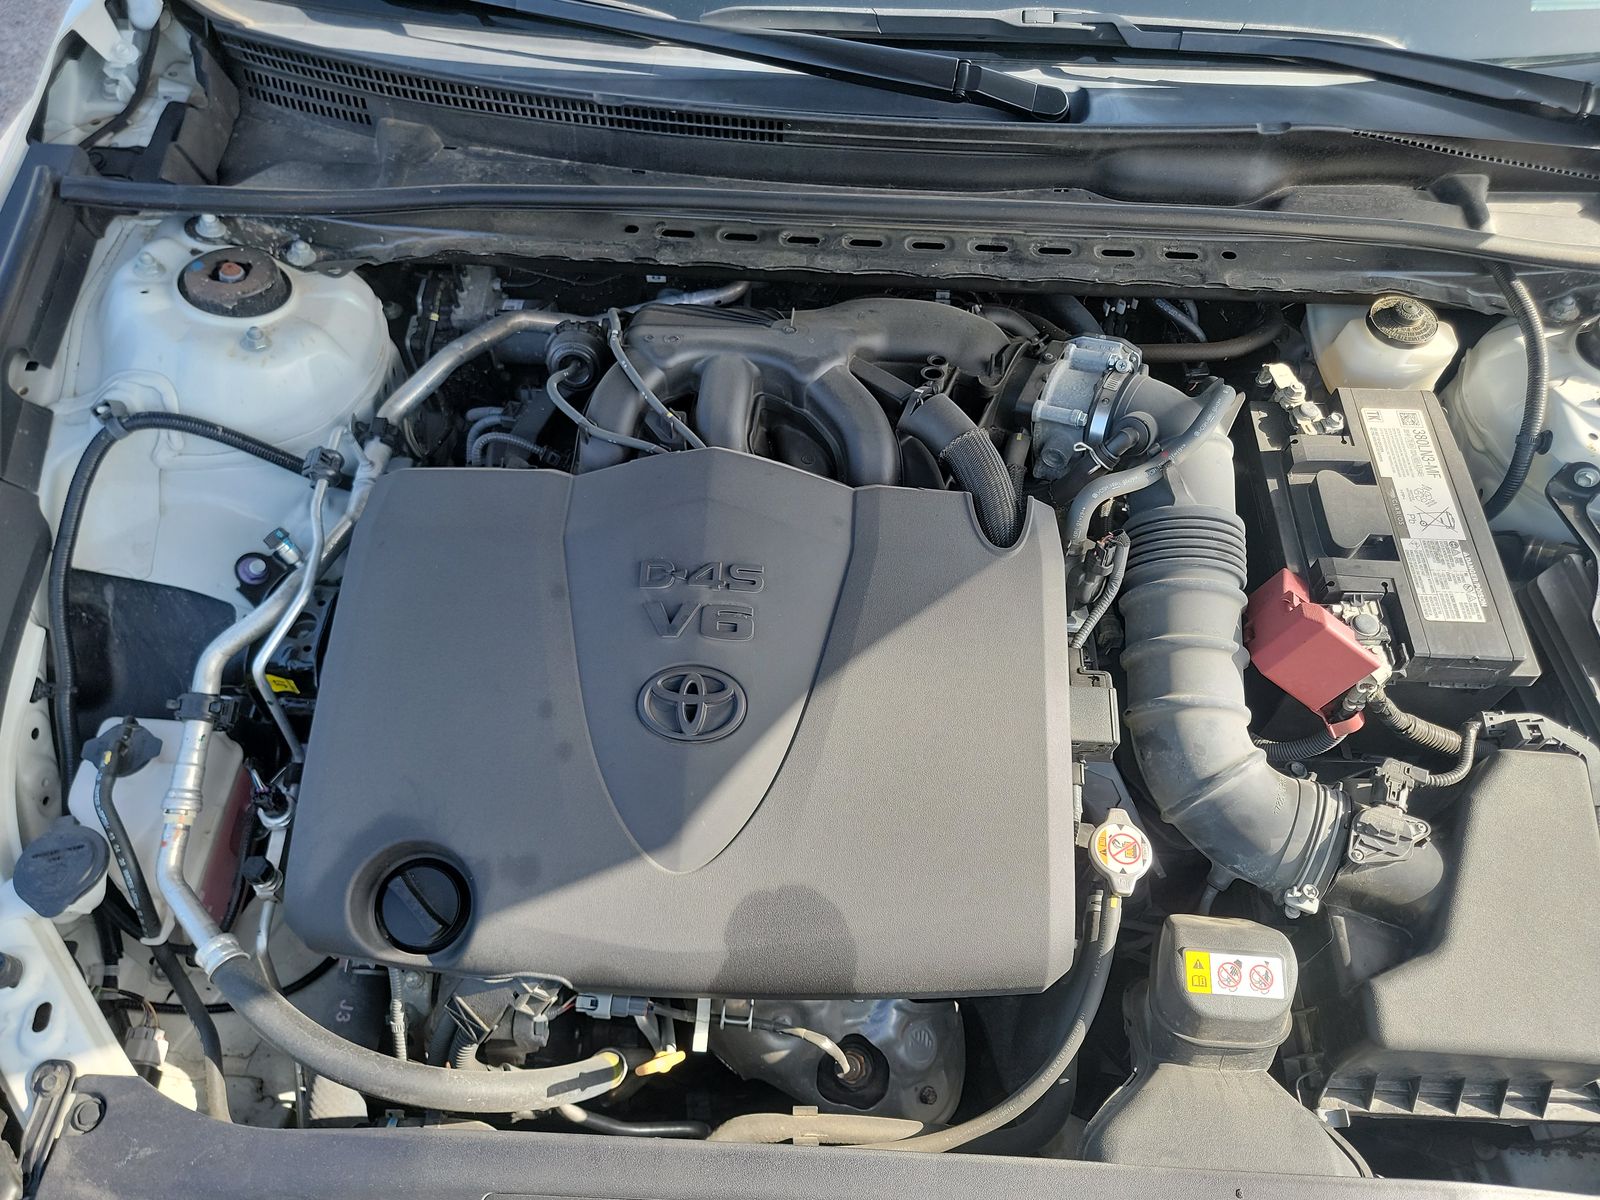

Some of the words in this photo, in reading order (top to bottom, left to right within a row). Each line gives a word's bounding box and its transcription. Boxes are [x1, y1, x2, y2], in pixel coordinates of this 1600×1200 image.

[1412, 429, 1442, 479] 380LN3-MF
[1391, 498, 1405, 526] CLARIOS
[1407, 513, 1416, 525] Pb
[640, 560, 765, 593] D-4S
[642, 601, 755, 642] V6
[336, 999, 354, 1022] J3
